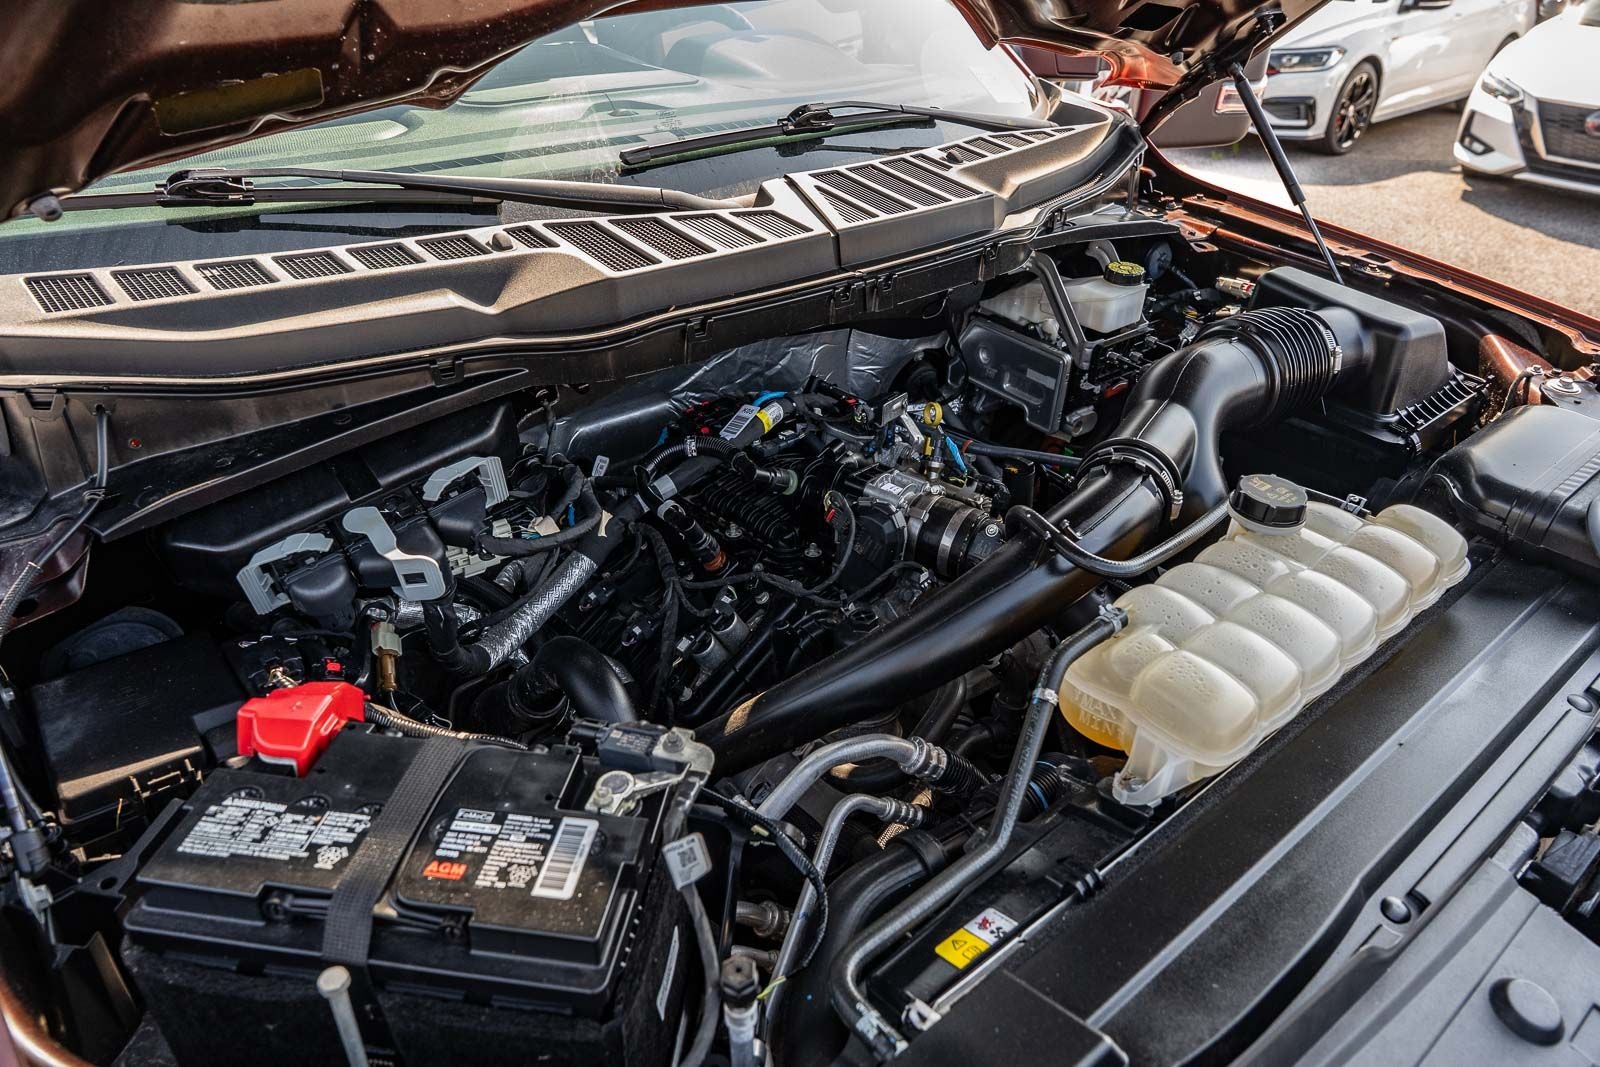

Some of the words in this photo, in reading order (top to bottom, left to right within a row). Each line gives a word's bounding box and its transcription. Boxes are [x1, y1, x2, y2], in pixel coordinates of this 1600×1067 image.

[1080, 693, 1117, 720] MAX
[1079, 709, 1114, 737] MIN
[425, 860, 468, 875] AGM
